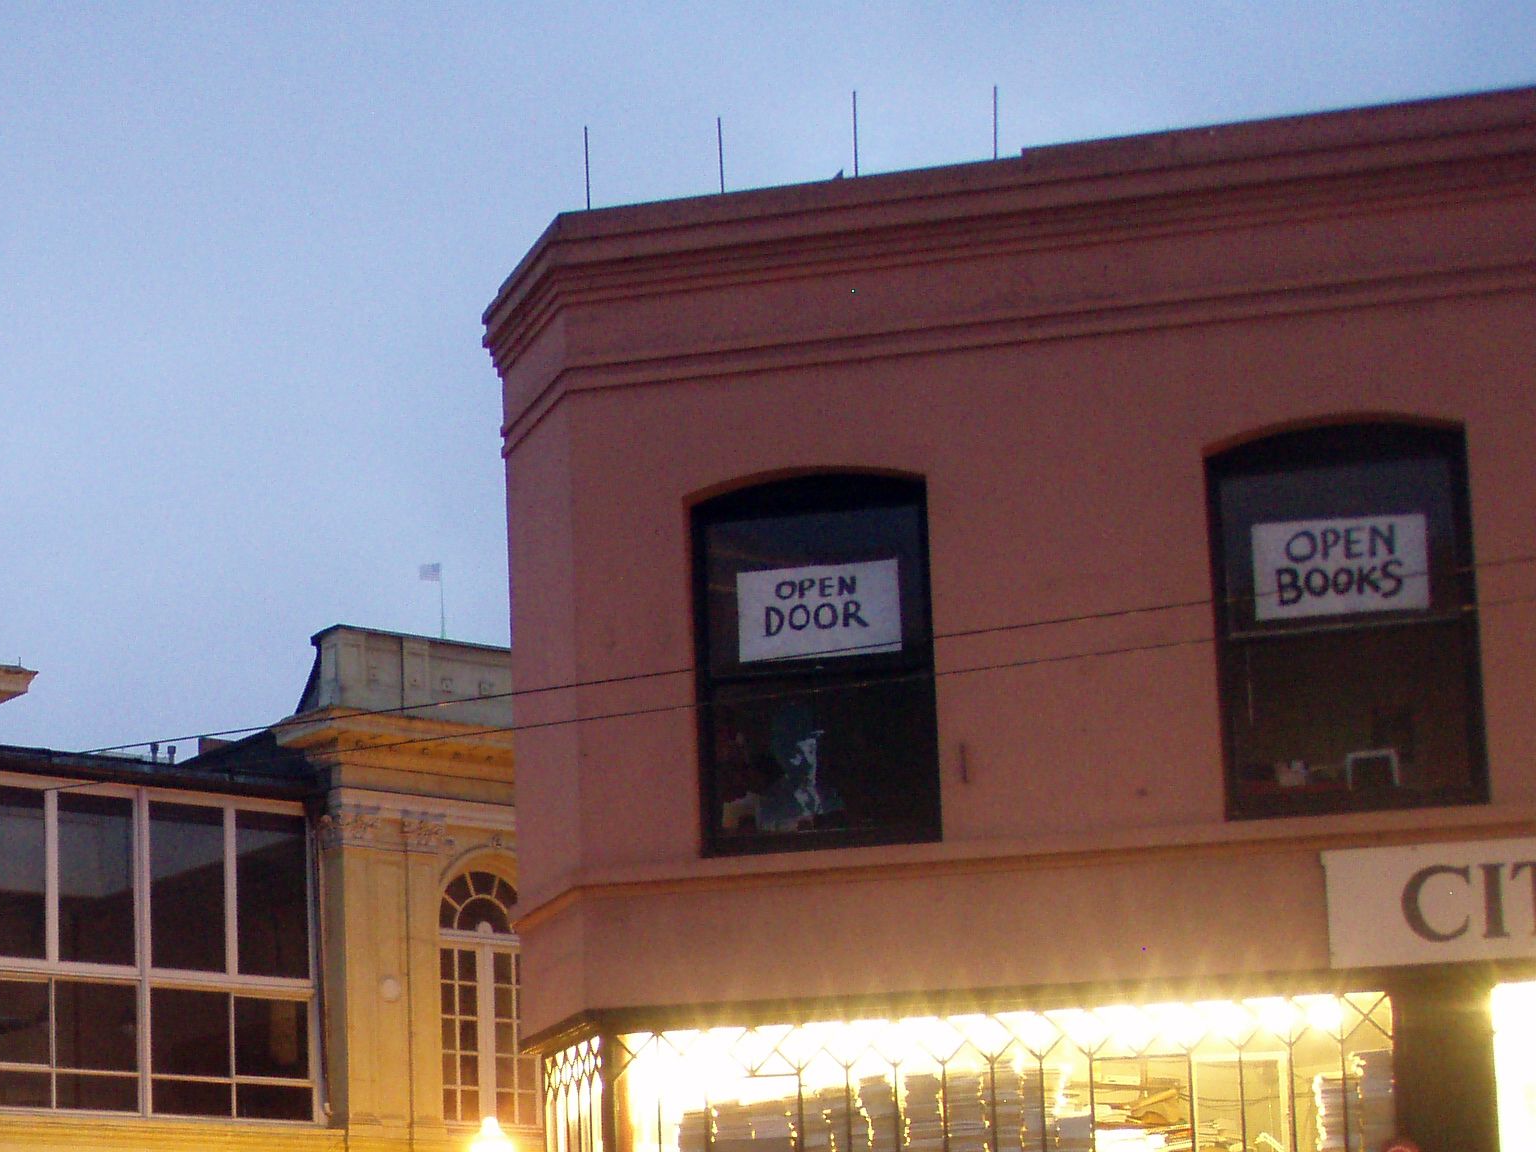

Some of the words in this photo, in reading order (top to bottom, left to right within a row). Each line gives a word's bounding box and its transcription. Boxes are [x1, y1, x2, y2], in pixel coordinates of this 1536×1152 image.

[1285, 523, 1396, 563] OPEN
[775, 576, 857, 600] OPEN
[1275, 559, 1403, 606] BOOKS
[763, 600, 869, 637] DOOR
